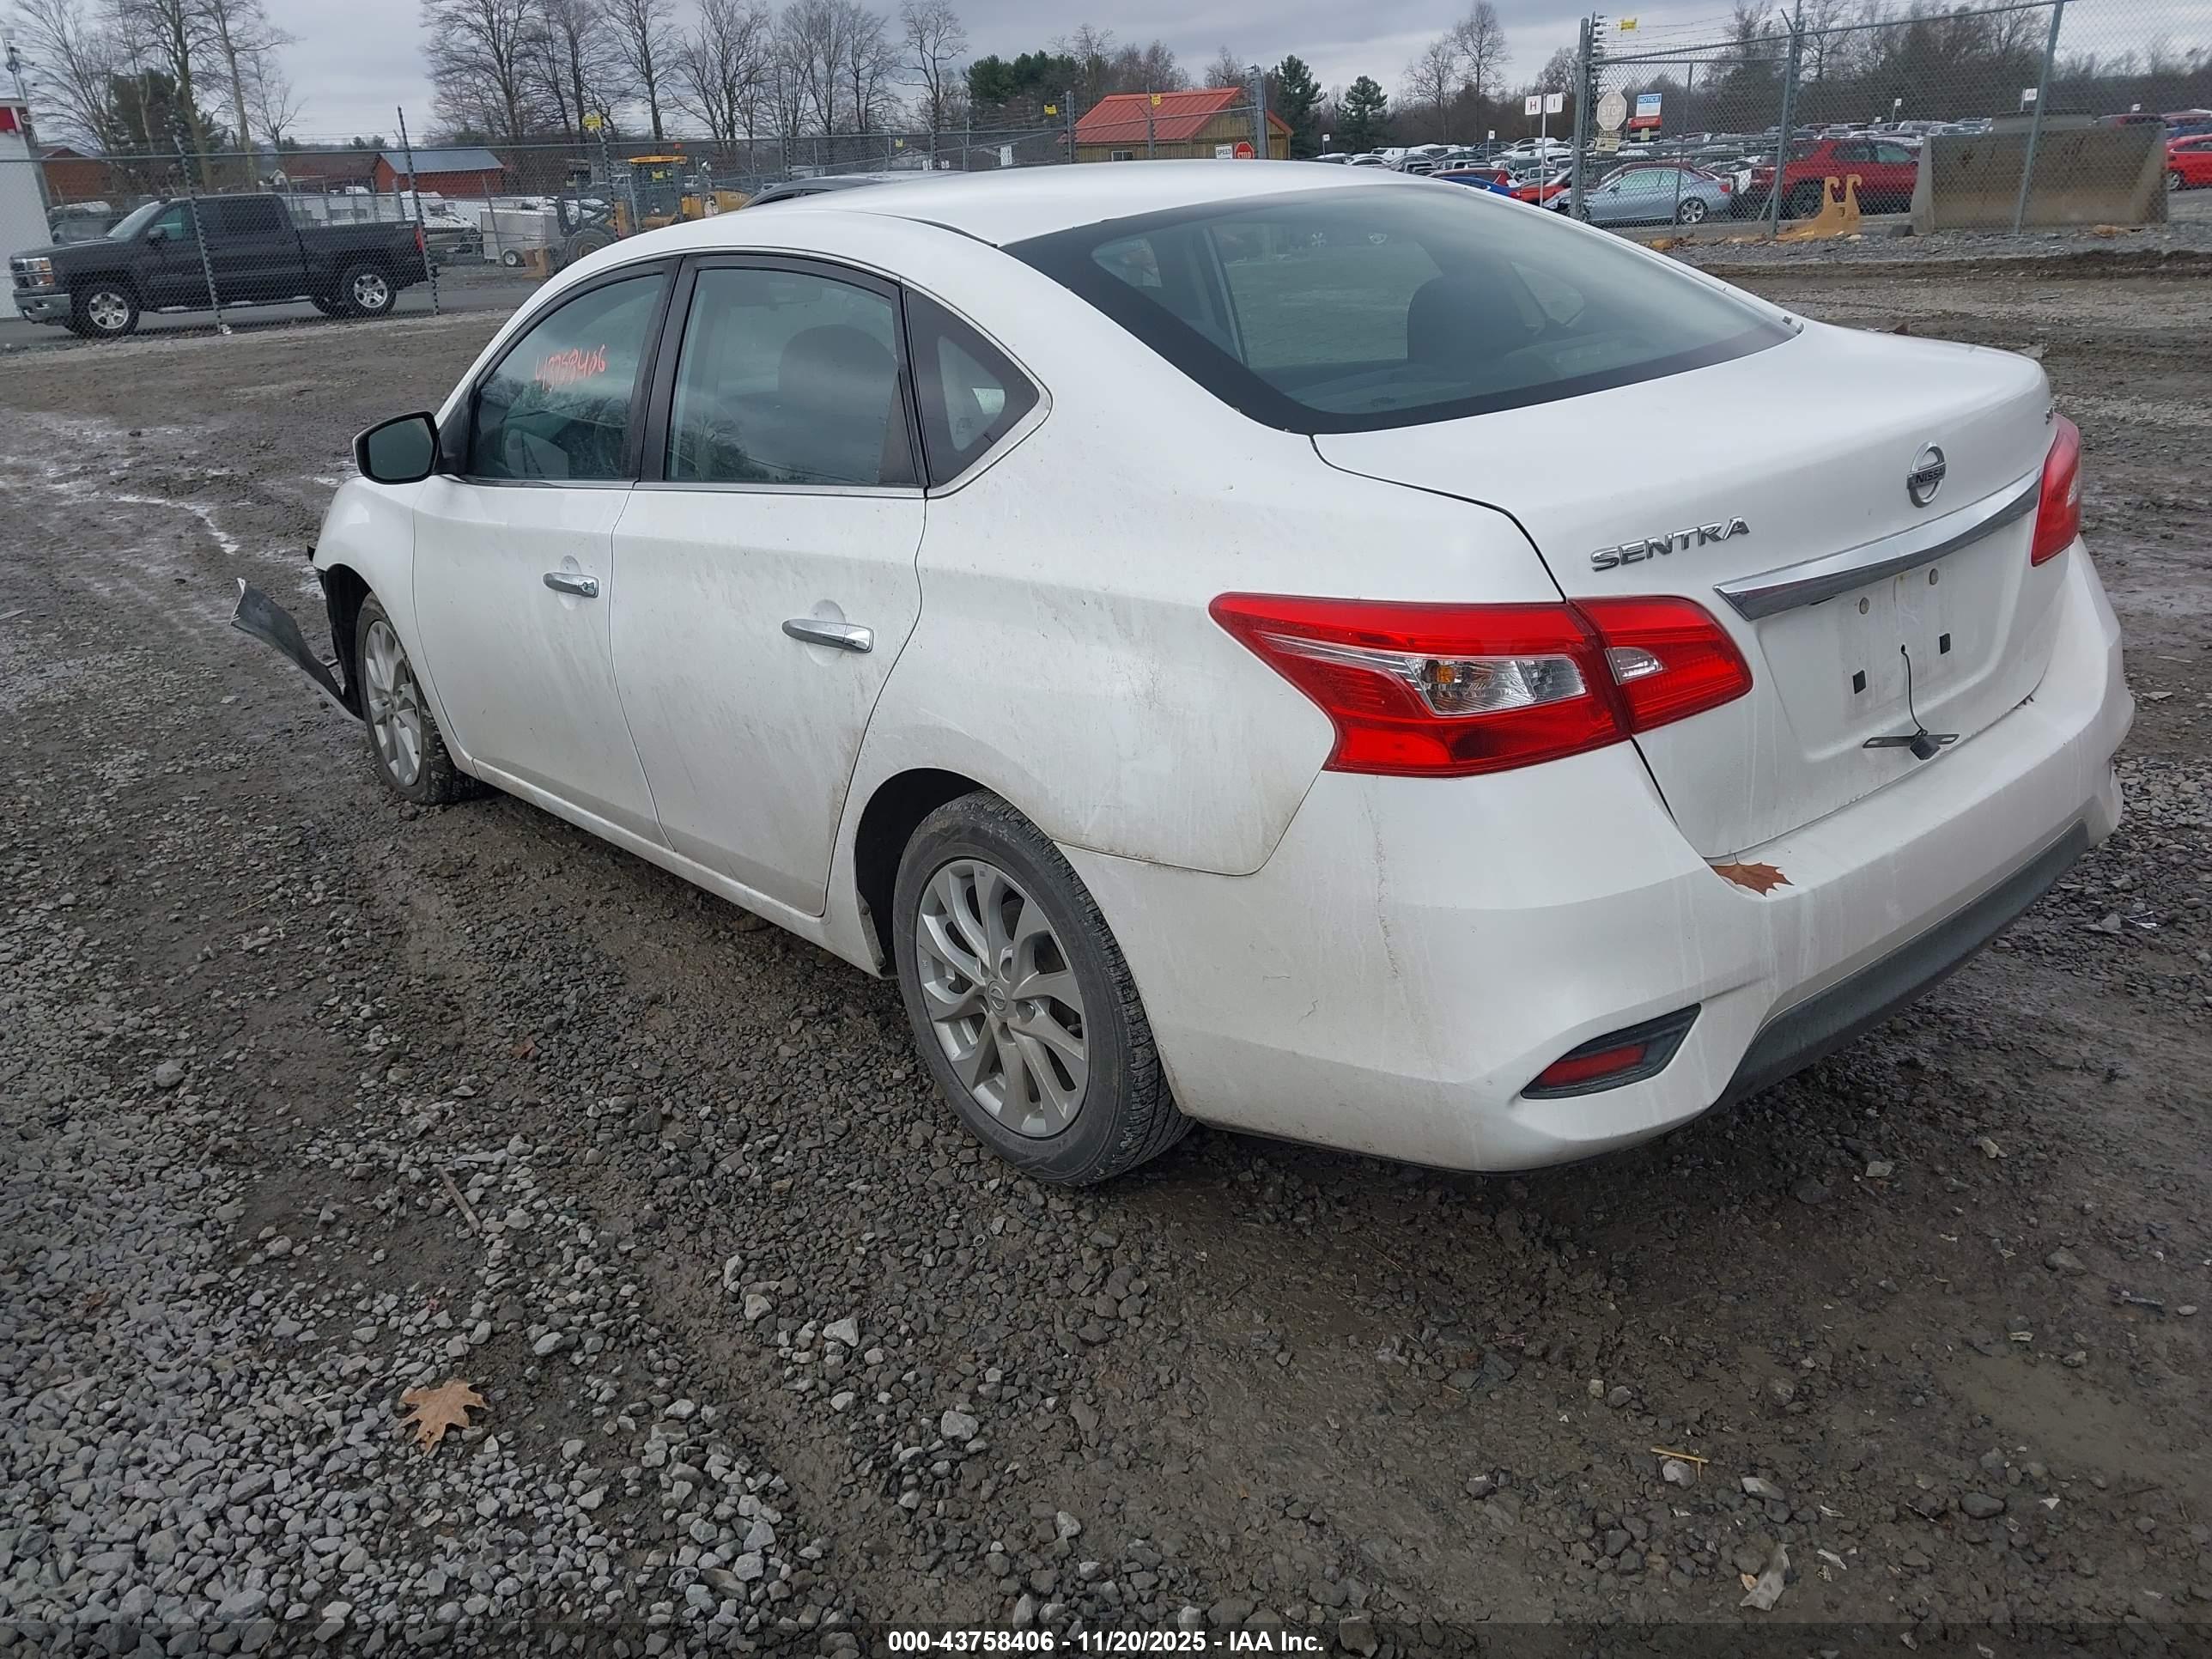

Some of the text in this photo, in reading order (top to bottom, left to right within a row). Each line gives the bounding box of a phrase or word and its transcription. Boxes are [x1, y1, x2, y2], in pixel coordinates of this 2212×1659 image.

[1529, 100, 1537, 111] H
[1601, 105, 1623, 116] STOP
[1590, 515, 1751, 573] SENTRA
